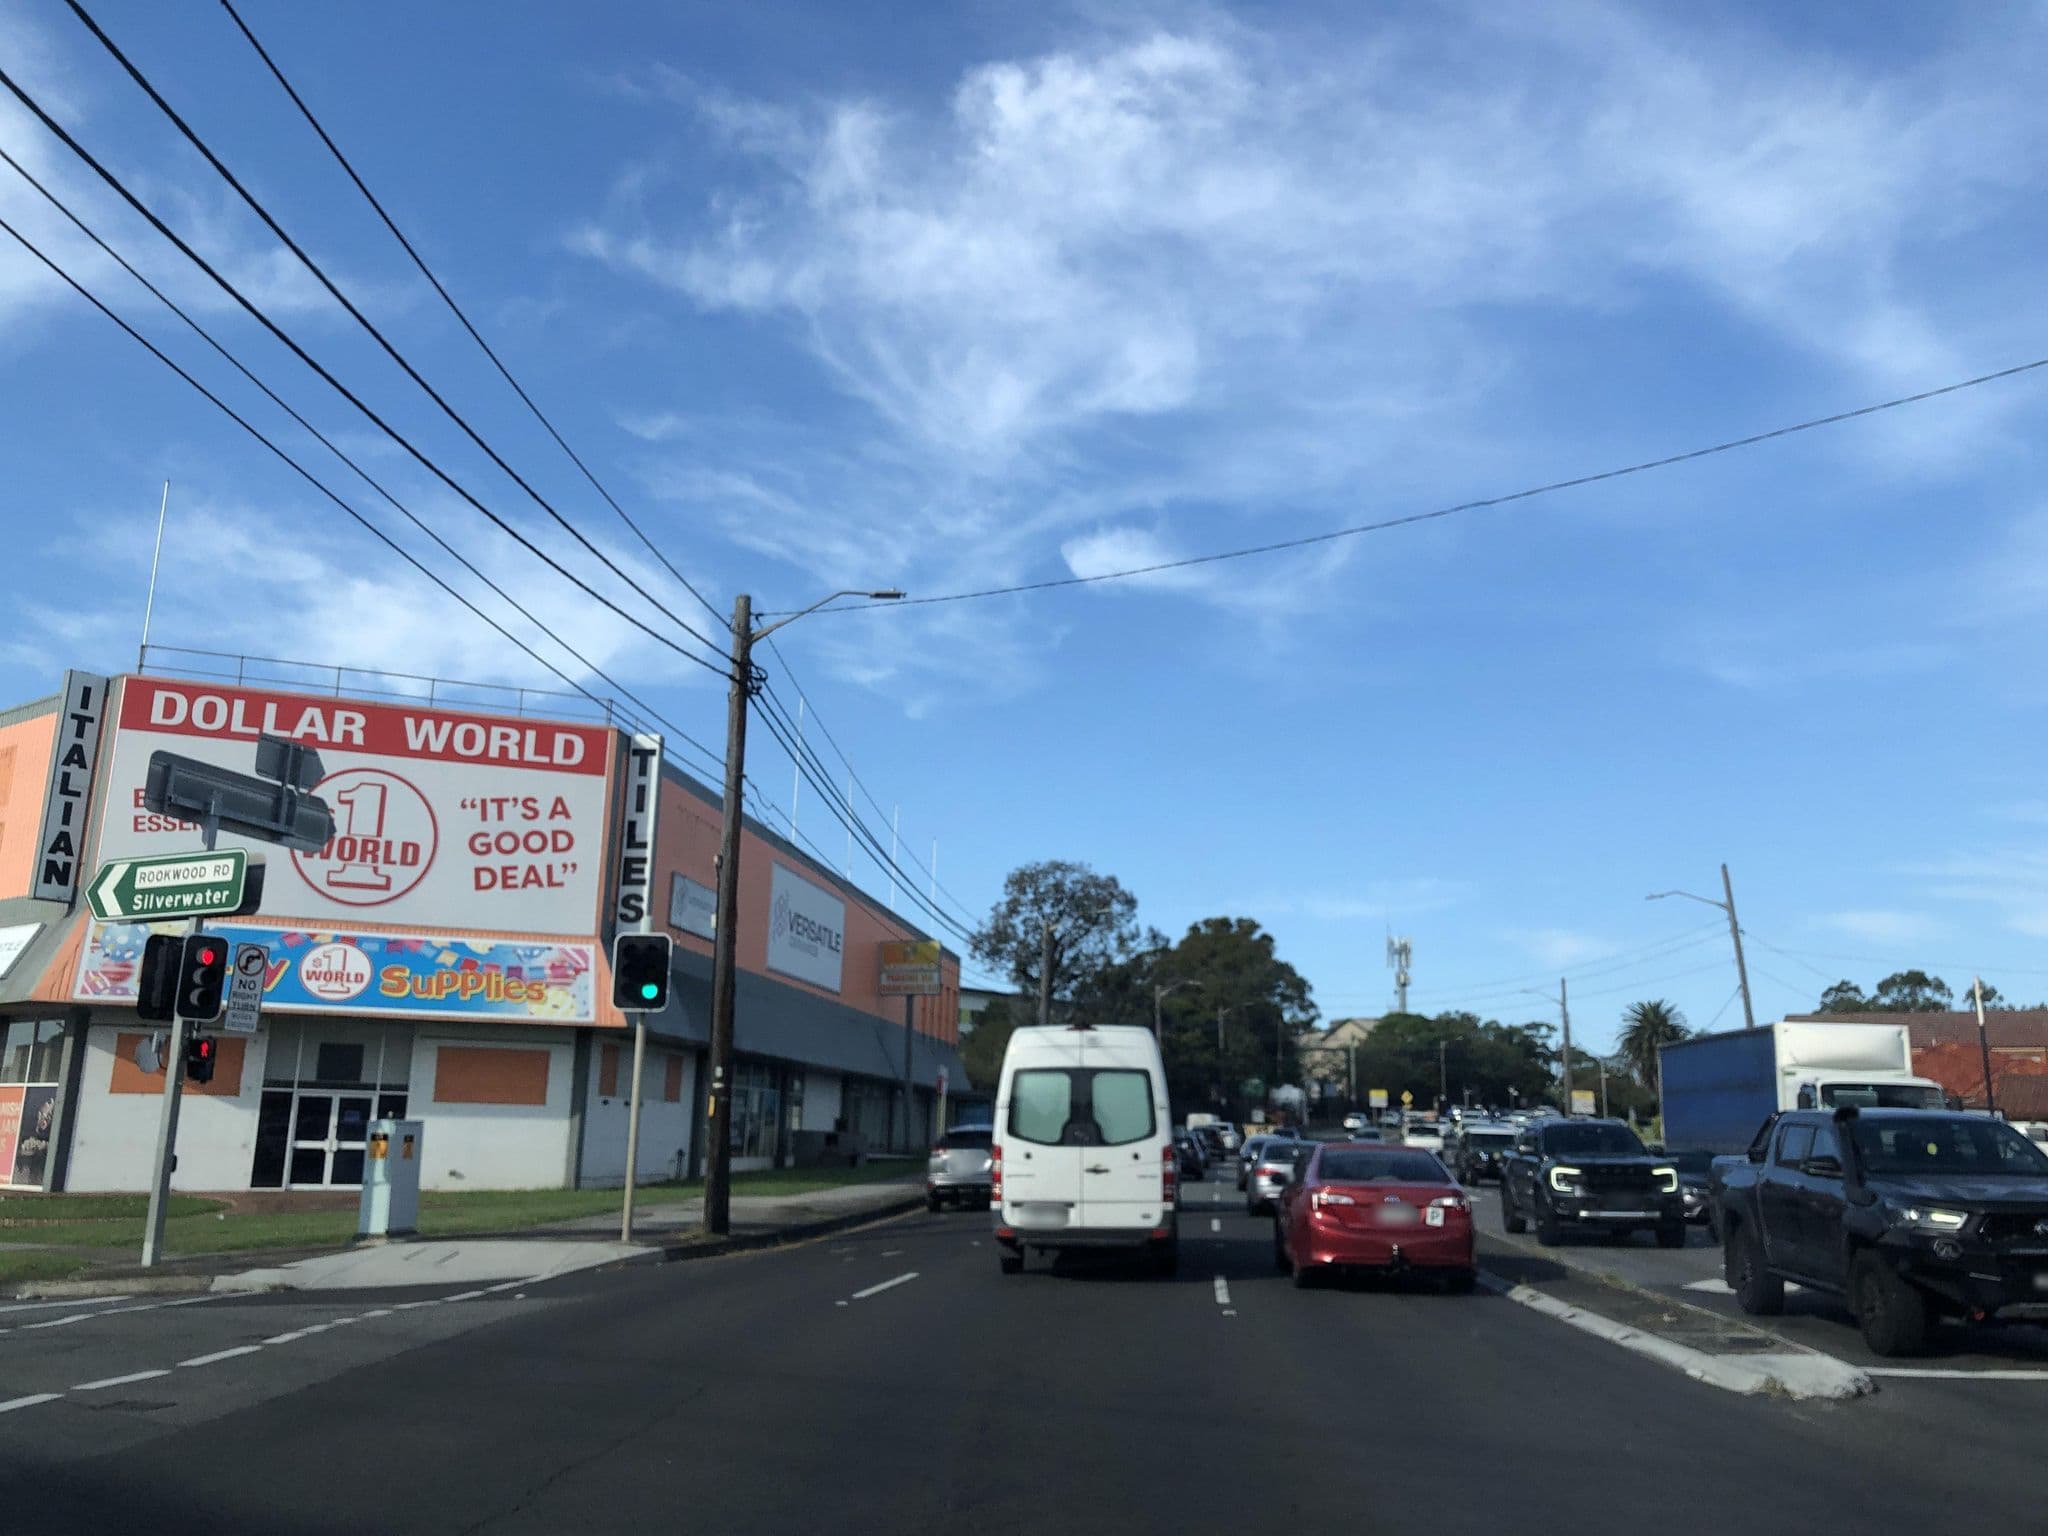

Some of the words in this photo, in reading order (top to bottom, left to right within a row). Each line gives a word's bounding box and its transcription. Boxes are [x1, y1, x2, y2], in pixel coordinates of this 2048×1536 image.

[150, 689, 366, 746] DOLLAR
[404, 716, 585, 766] WORLD
[43, 686, 95, 887] ITALIAN
[548, 796, 572, 820] A
[468, 829, 575, 856] GOOD
[618, 748, 657, 923] TILES
[139, 866, 207, 884] ROOKWOOD
[213, 863, 230, 878] RD
[132, 887, 230, 912] Silverwater
[788, 909, 841, 952] VERSATILE
[238, 978, 257, 991] NO
[306, 970, 364, 983] WORLD
